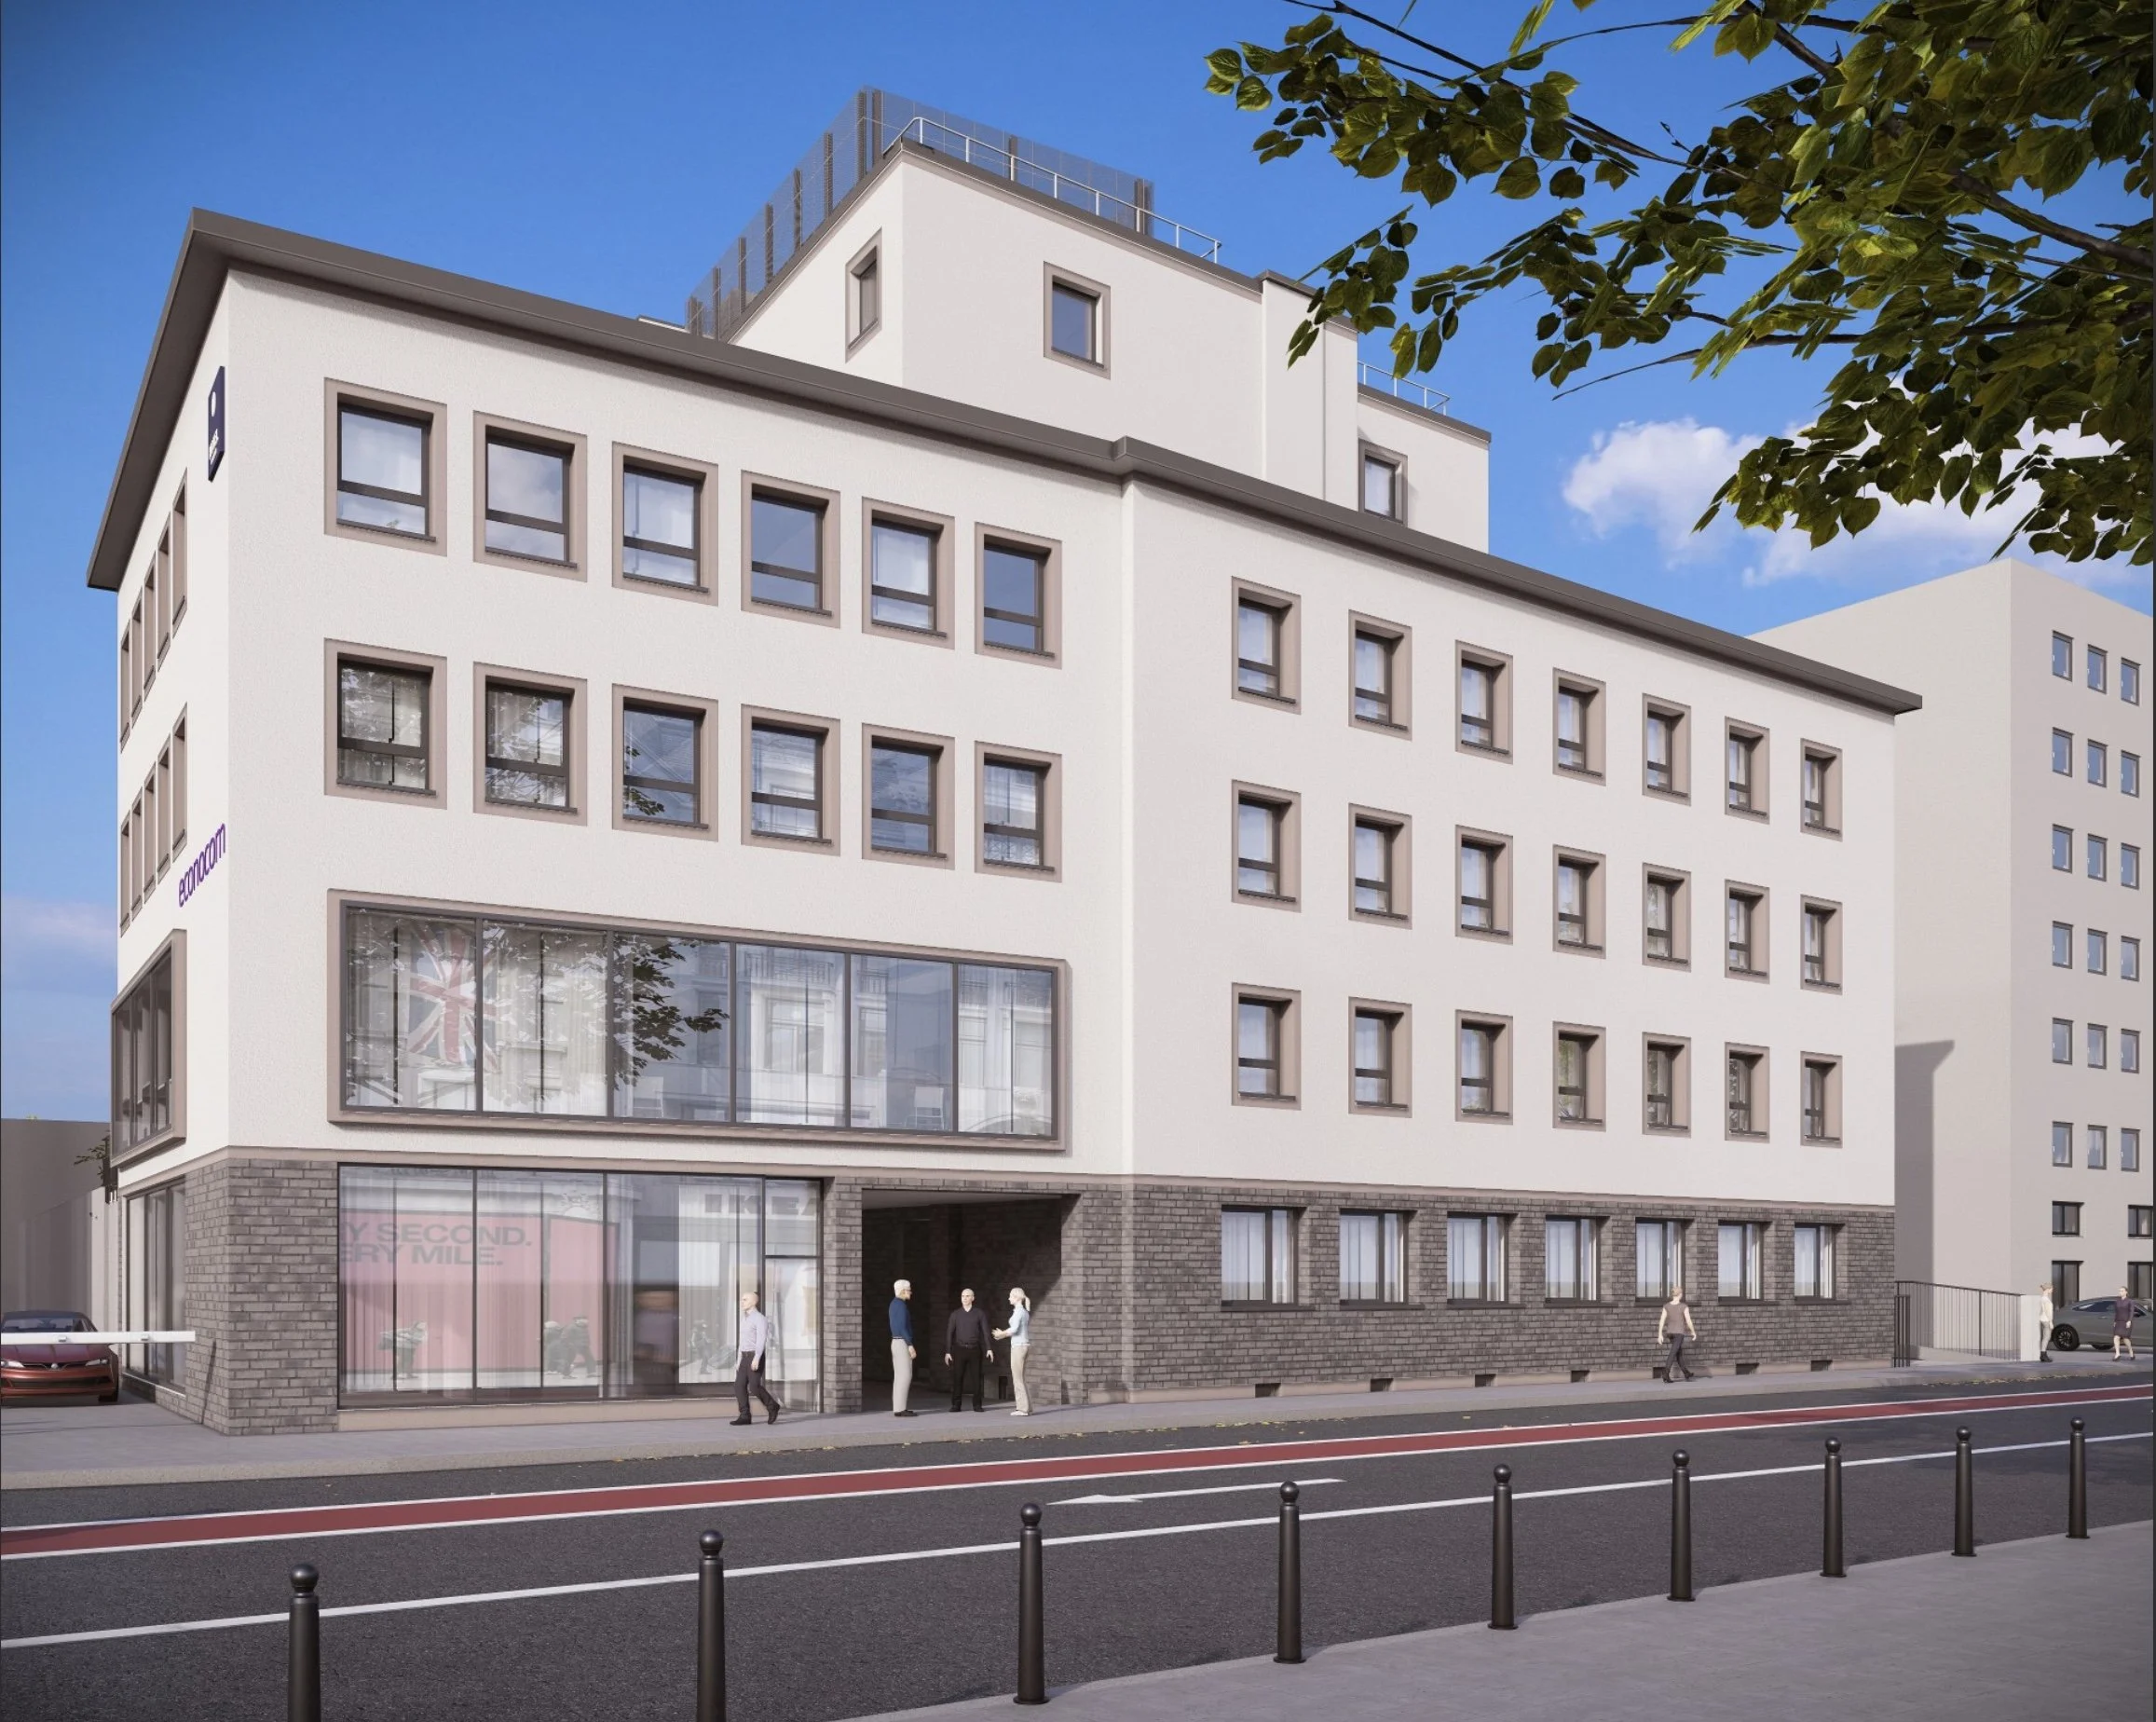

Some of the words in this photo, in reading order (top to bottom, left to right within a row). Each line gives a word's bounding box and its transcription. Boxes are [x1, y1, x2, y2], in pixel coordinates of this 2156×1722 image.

[178, 823, 226, 908] econocom
[376, 1222, 533, 1247] SECOND.
[411, 1245, 504, 1266] MILE.
